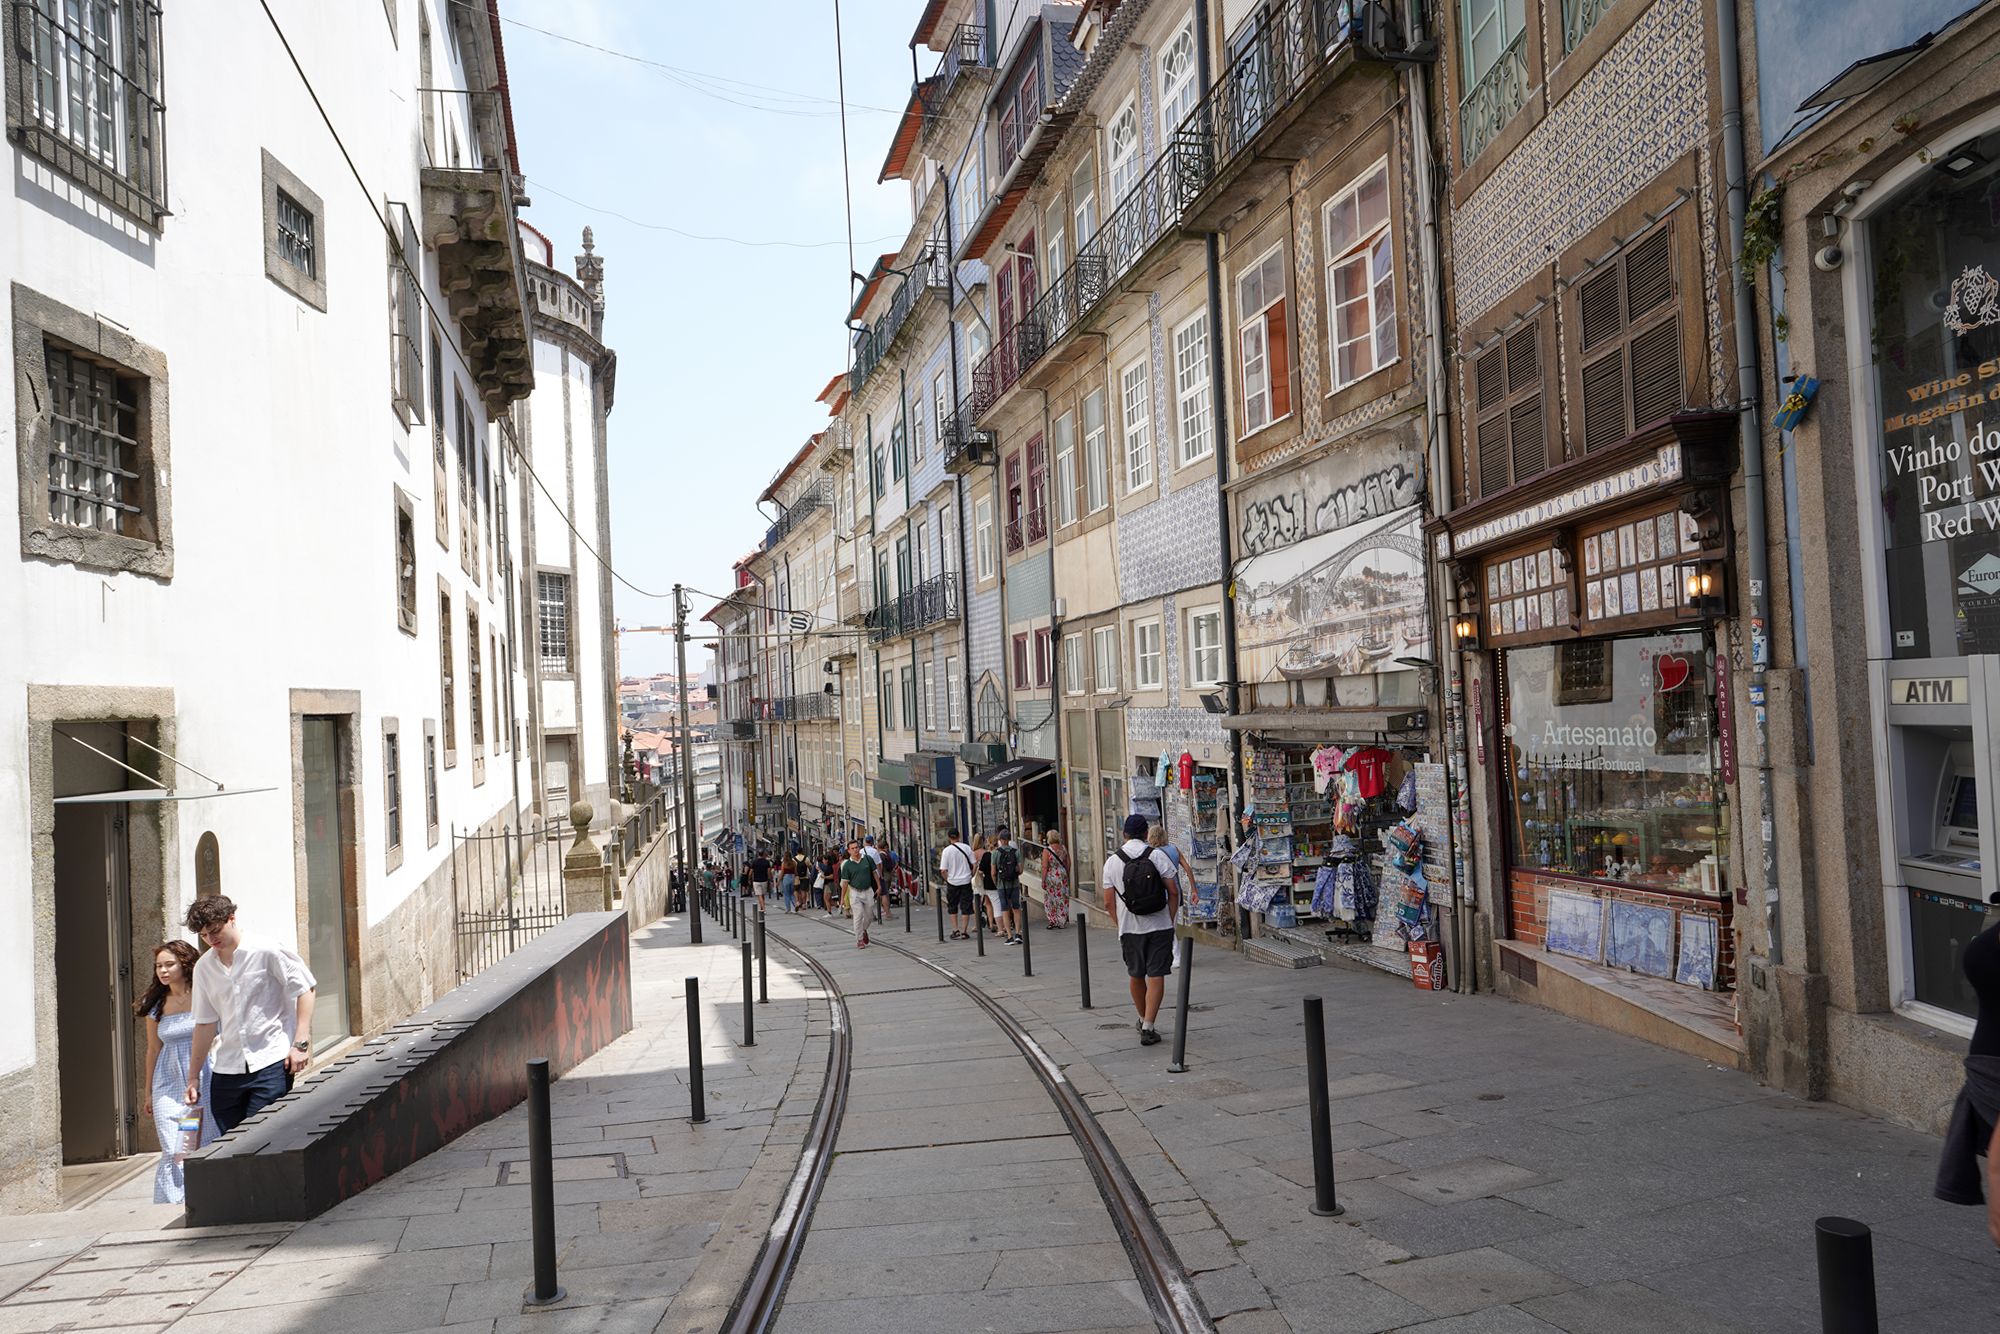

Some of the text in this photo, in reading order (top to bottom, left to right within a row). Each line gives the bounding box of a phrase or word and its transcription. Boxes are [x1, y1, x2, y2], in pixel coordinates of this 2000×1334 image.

[1907, 357, 2000, 403] Wine S
[1884, 392, 1987, 434] Magasin
[1662, 448, 1677, 474] 34
[1887, 435, 1961, 476] Vinho
[1920, 474, 1974, 506] Port
[1455, 513, 1531, 550] ARTESANATO
[1538, 499, 1563, 520] DOS
[1924, 502, 1974, 542] Red
[1960, 599, 2000, 607] WORLD
[1905, 680, 1953, 703] ATM
[1542, 720, 1658, 747] Artesanato
[1719, 681, 1731, 777] ARTE SACRA
[1365, 765, 1373, 780] 7
[1553, 756, 1645, 774] made in Portugal
[1434, 952, 1443, 990] mailbox
